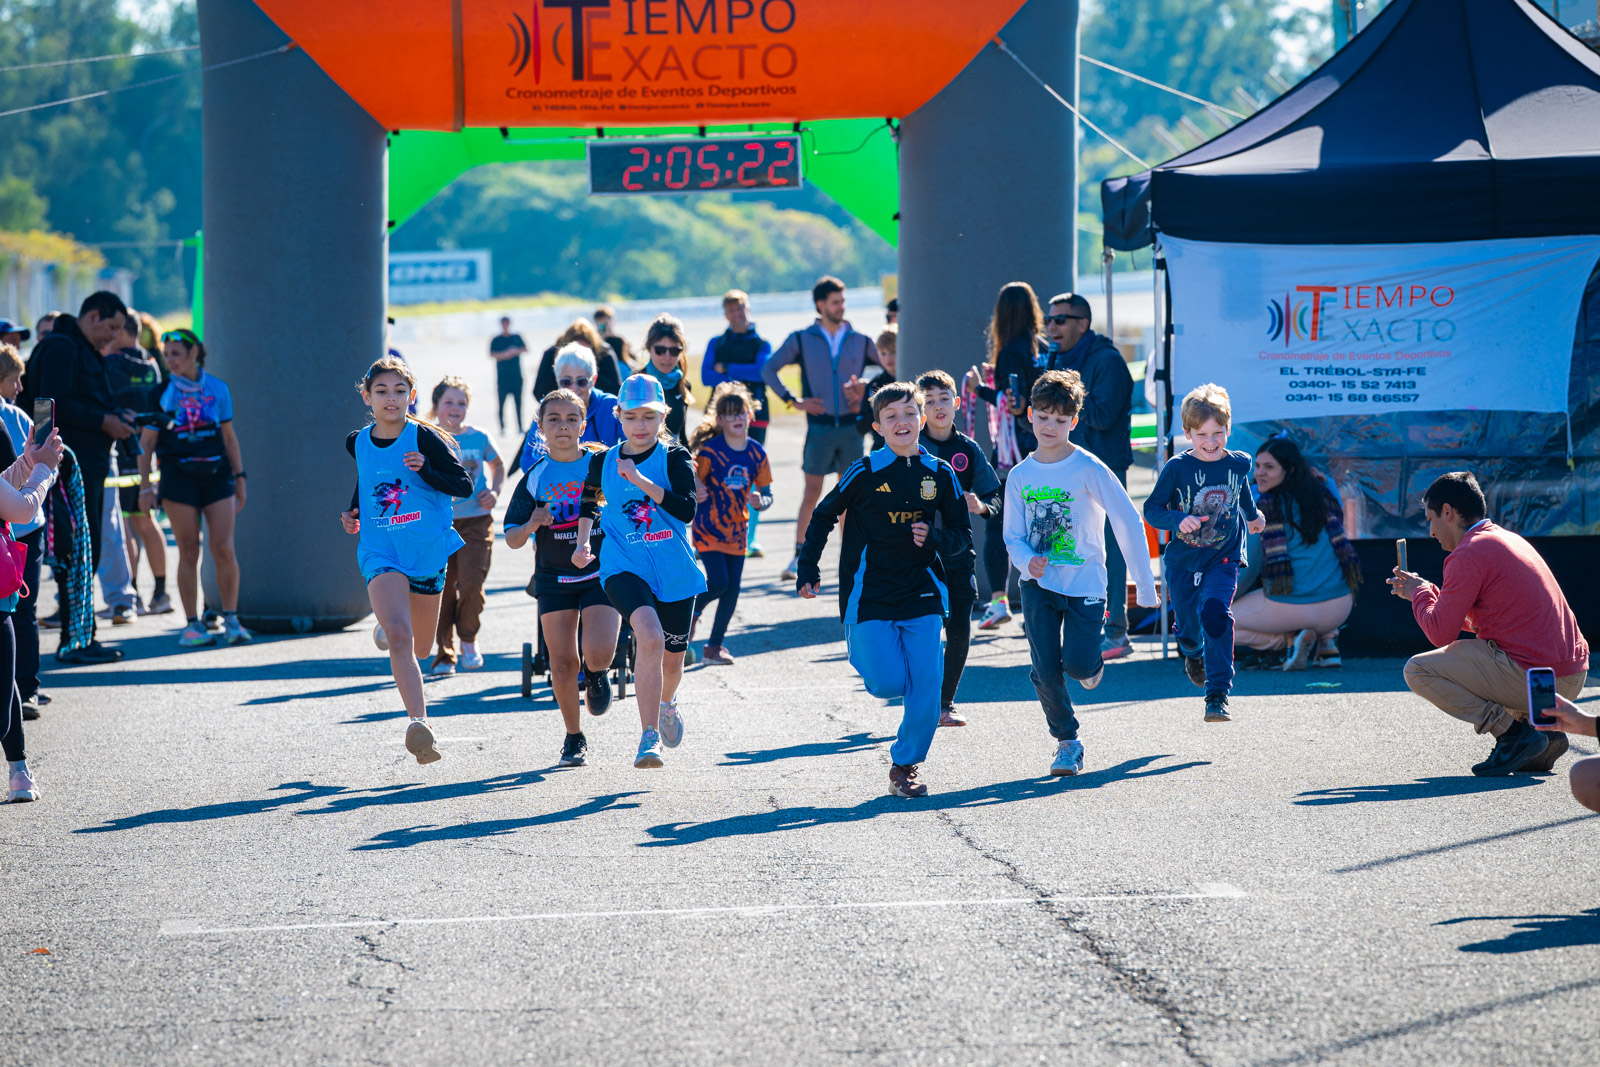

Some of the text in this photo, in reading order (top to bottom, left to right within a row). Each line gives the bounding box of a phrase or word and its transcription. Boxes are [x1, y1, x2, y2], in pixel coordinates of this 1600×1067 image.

[505, 83, 797, 101] Cronometraje de Eventos Deportivos
[622, 141, 795, 190] 2:05:22
[1259, 349, 1451, 361] Cronometraje de Eventos Deportivos
[1280, 367, 1299, 375] EL
[1289, 381, 1416, 389] 03401- 15 52 7413
[1285, 394, 1420, 402] 0341- 15 68 66557
[566, 481, 585, 499] 5
[1022, 485, 1066, 502] Custom
[549, 499, 580, 522] RU
[888, 511, 922, 524] YPF
[554, 532, 577, 540] RAFAELA
